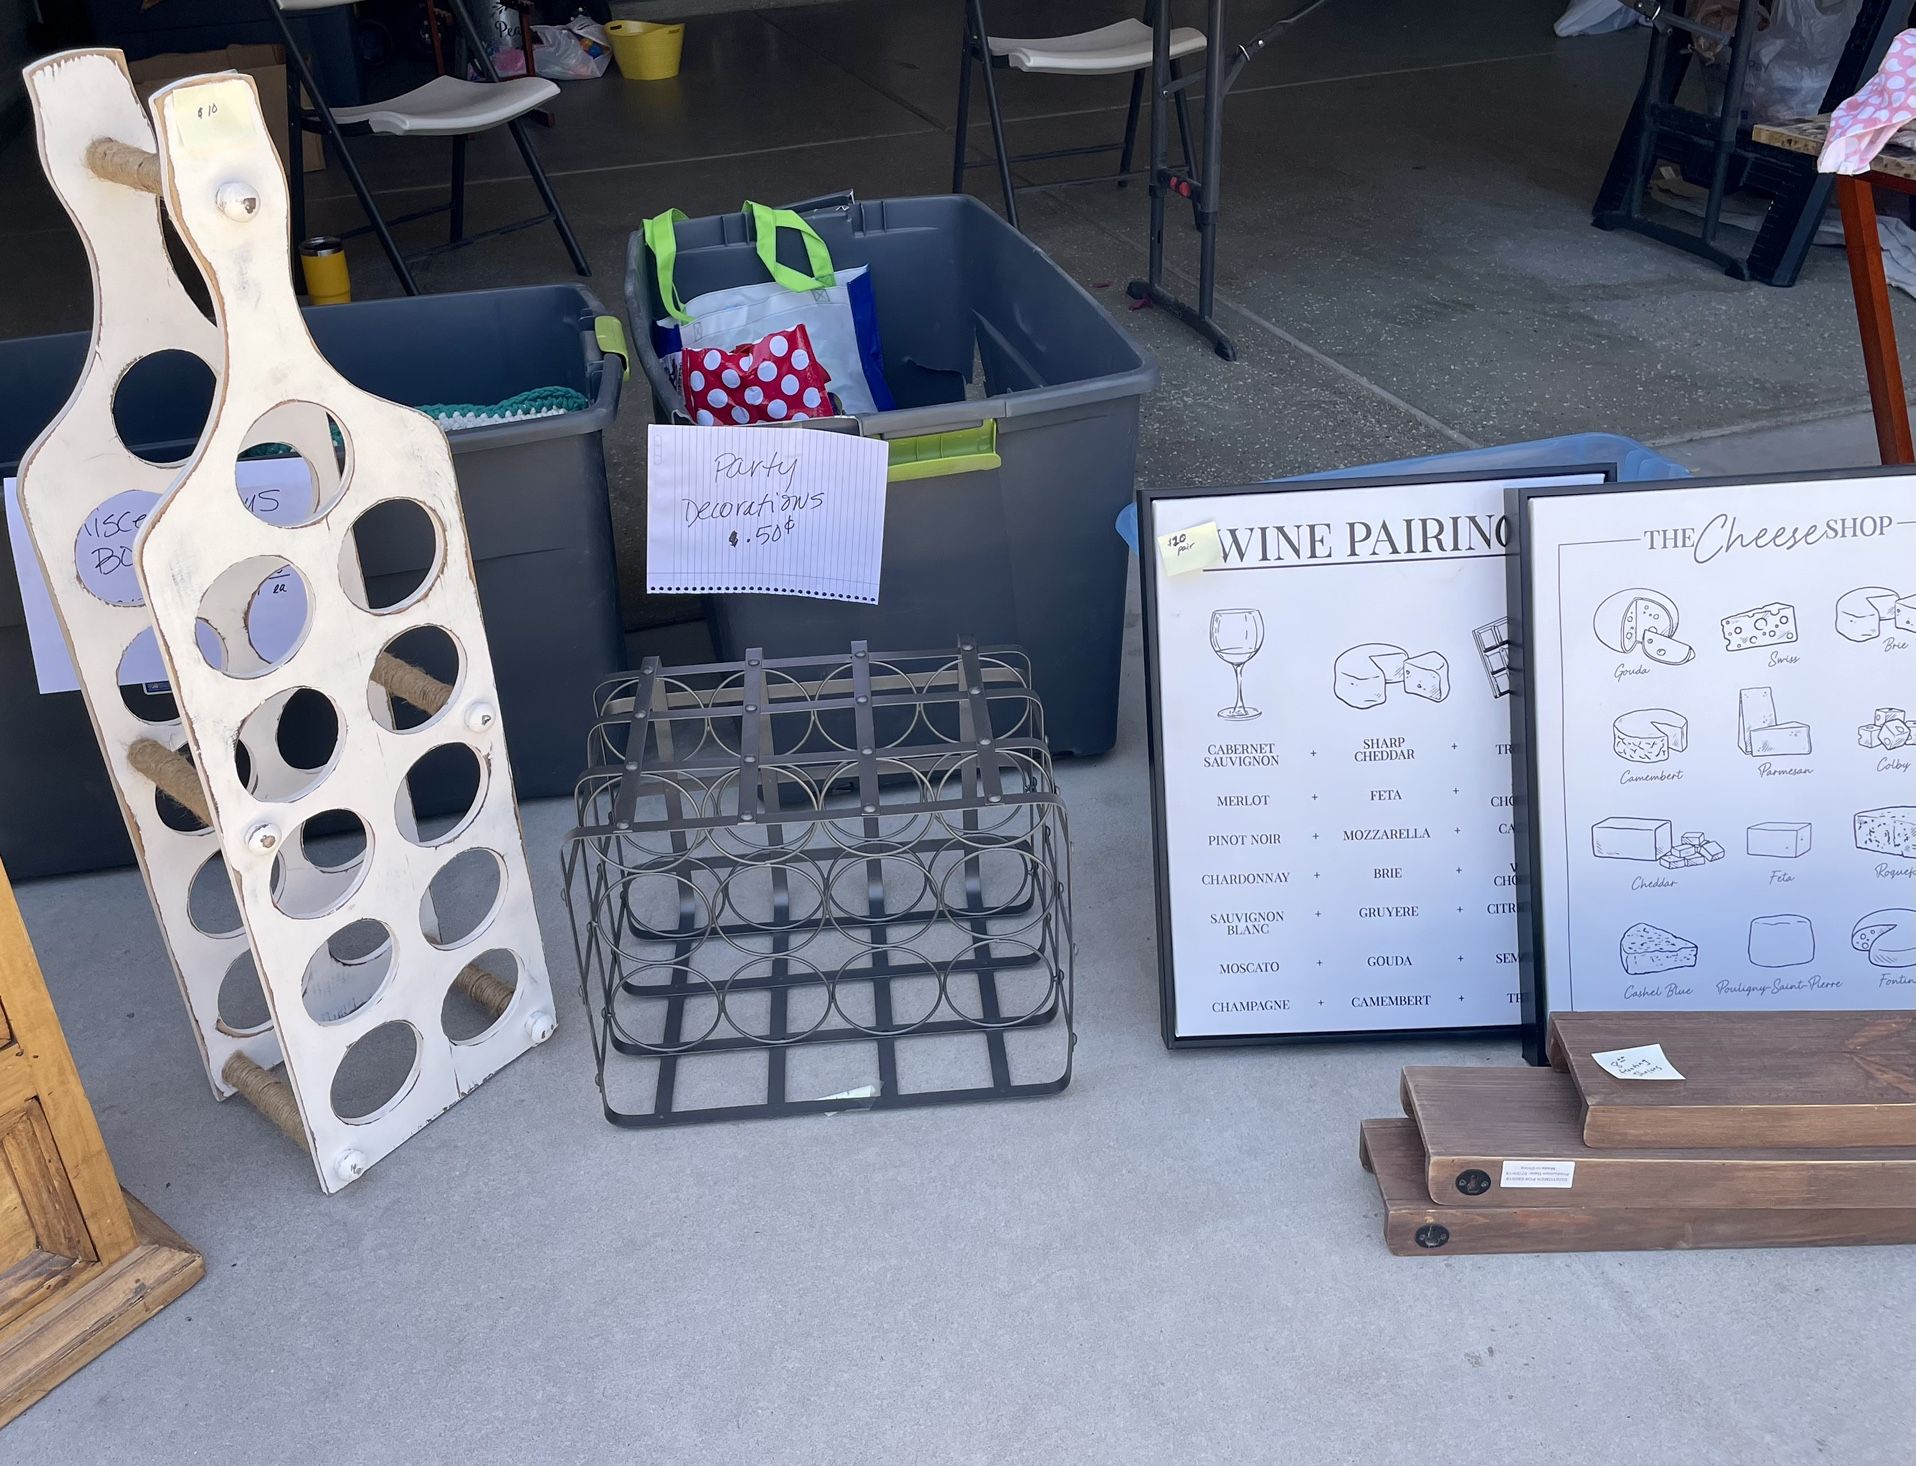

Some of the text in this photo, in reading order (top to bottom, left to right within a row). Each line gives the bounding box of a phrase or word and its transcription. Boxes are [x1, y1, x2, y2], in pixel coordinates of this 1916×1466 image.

[714, 451, 798, 493] Party
[1217, 521, 1332, 564] WINE
[1643, 513, 1893, 564] THE Cheese SHOP
[1882, 636, 1910, 653] Brie
[1767, 650, 1801, 668] Swiss
[1613, 662, 1651, 683] Gouda
[1207, 742, 1276, 755] CABERNET
[1362, 736, 1406, 750] SHARP
[1203, 754, 1280, 768] SAUVIGNON
[1354, 748, 1416, 762] CHEDDAR
[1757, 761, 1815, 779] Parmesan
[1876, 756, 1912, 774] Colby
[1619, 769, 1684, 785] Camembert
[1216, 794, 1271, 807] MERLOT
[1370, 789, 1403, 801] FETA
[1208, 833, 1281, 846] PINOT NOIR
[1343, 827, 1431, 841] MOZZARELLA
[1201, 871, 1290, 886] CHARDONNAY
[1373, 867, 1403, 879] BRIE
[1768, 869, 1796, 886] Feta
[1631, 875, 1679, 891] Cheddar
[1209, 910, 1285, 925] SAUVIGNON
[1358, 905, 1419, 919] GRUYERE
[1226, 924, 1270, 936] BLANC
[1219, 961, 1280, 975] MOSCATO
[1367, 955, 1413, 967] GOUDA
[1623, 982, 1694, 1000] Cashel Blue
[1715, 974, 1844, 997] Pouligny-Saint-Pierre
[1211, 999, 1291, 1013] CHAMPAGNE
[1351, 994, 1432, 1008] CAMEMBERT
